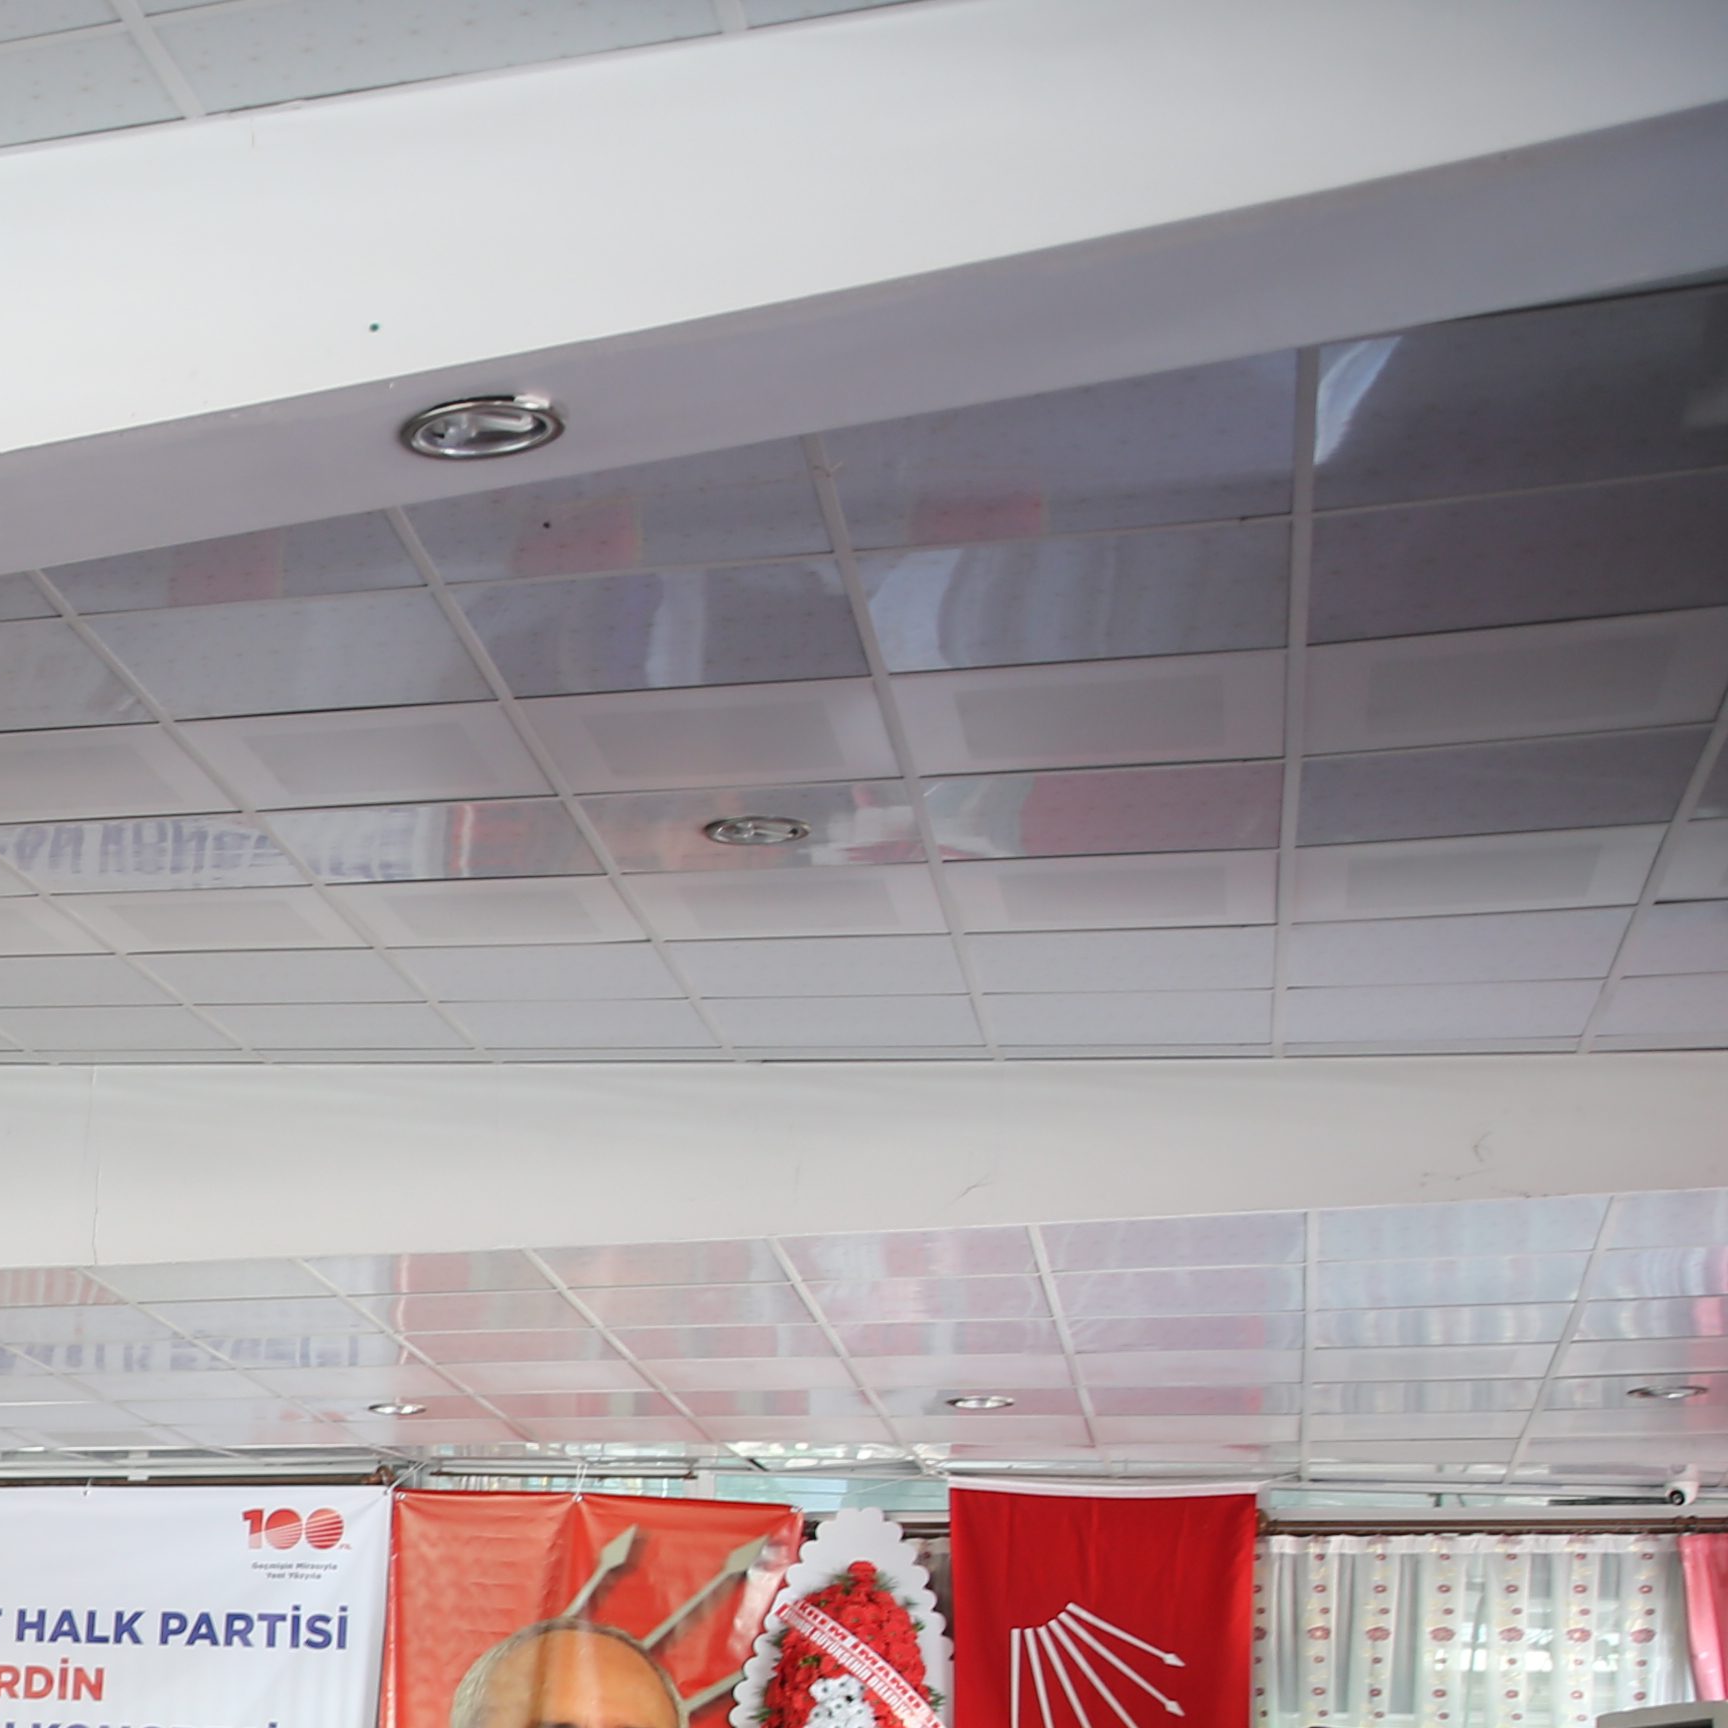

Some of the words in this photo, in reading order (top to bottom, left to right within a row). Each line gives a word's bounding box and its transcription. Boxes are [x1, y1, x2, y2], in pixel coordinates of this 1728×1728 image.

[242, 1508, 344, 1550] 100
[14, 1608, 144, 1645] HALK
[158, 1604, 348, 1650] PARTİSİ
